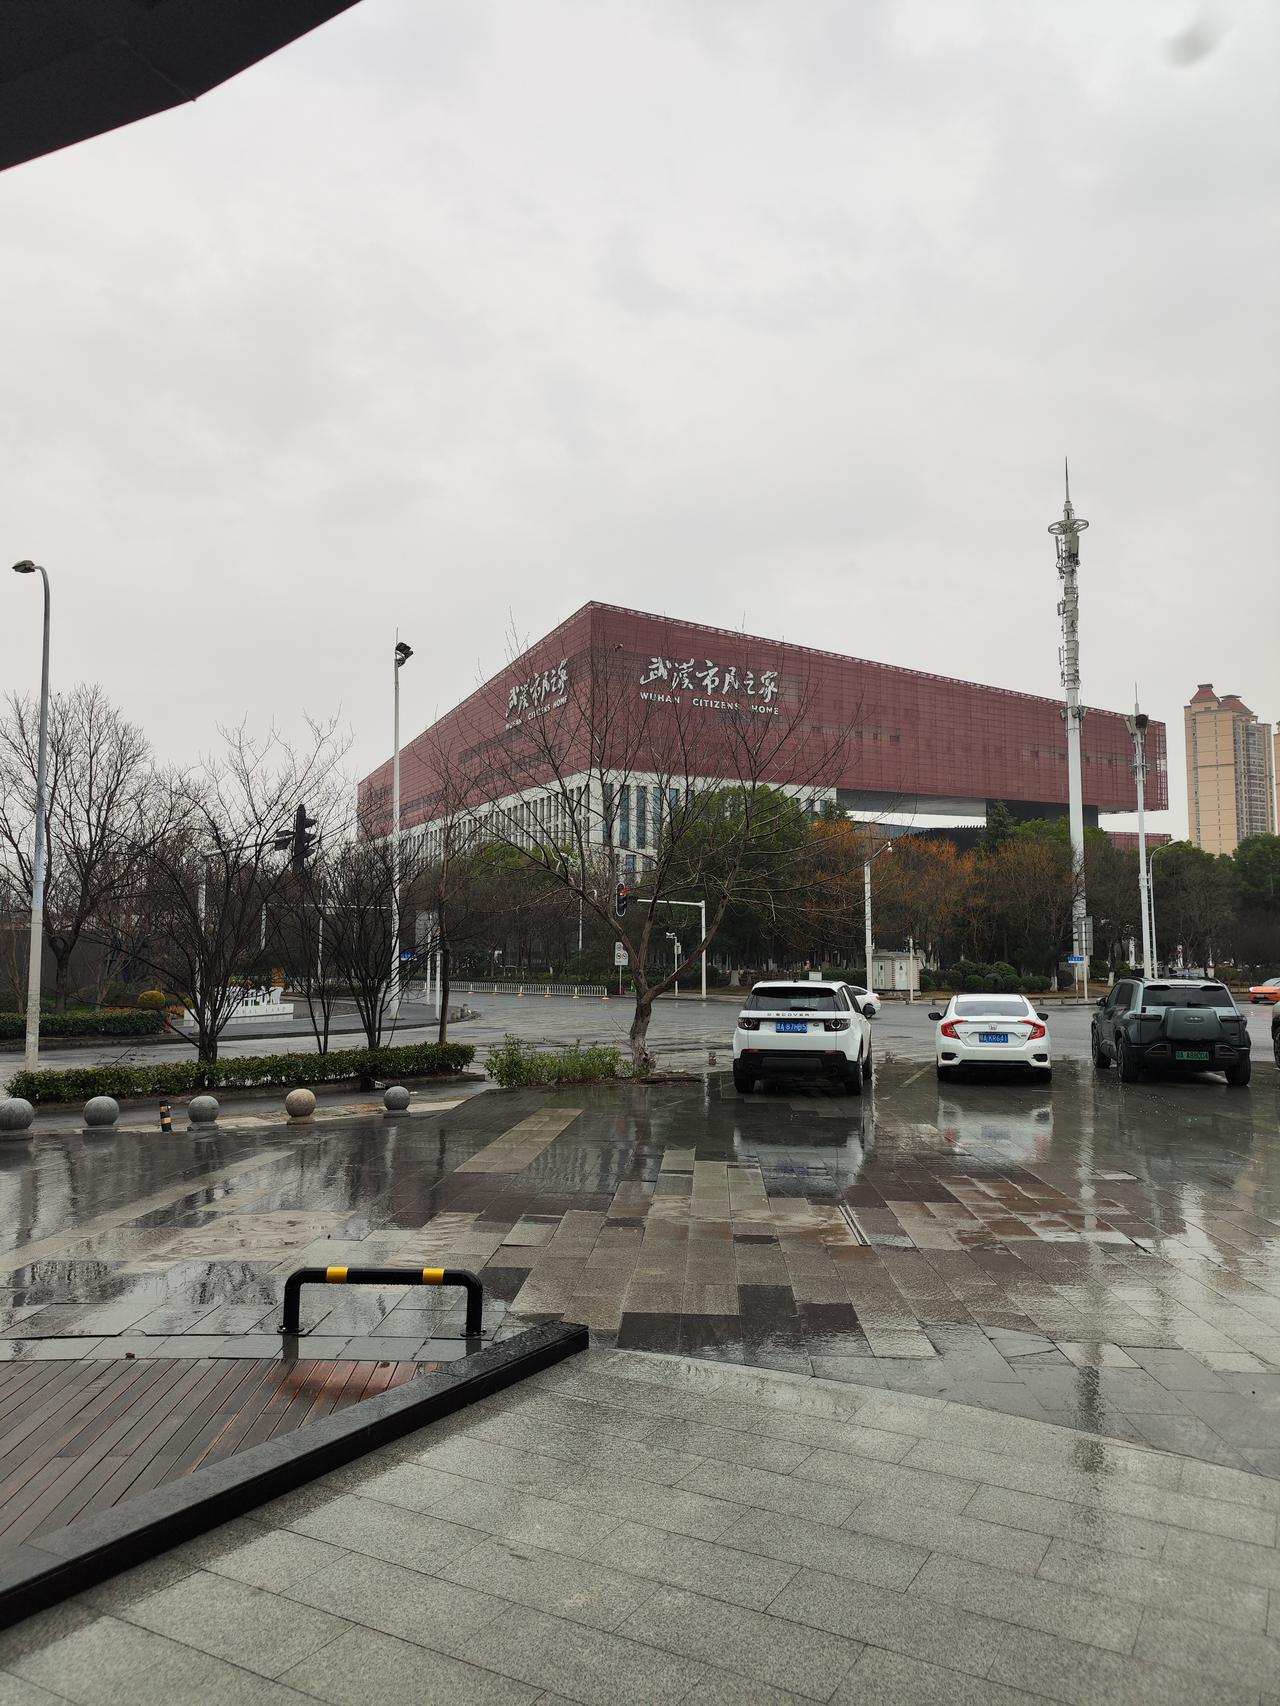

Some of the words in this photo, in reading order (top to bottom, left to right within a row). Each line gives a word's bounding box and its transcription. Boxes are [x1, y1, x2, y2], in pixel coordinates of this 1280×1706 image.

[640, 692, 680, 703] WUHAN
[692, 698, 740, 711] CITIZENS
[751, 704, 779, 715] HOME
